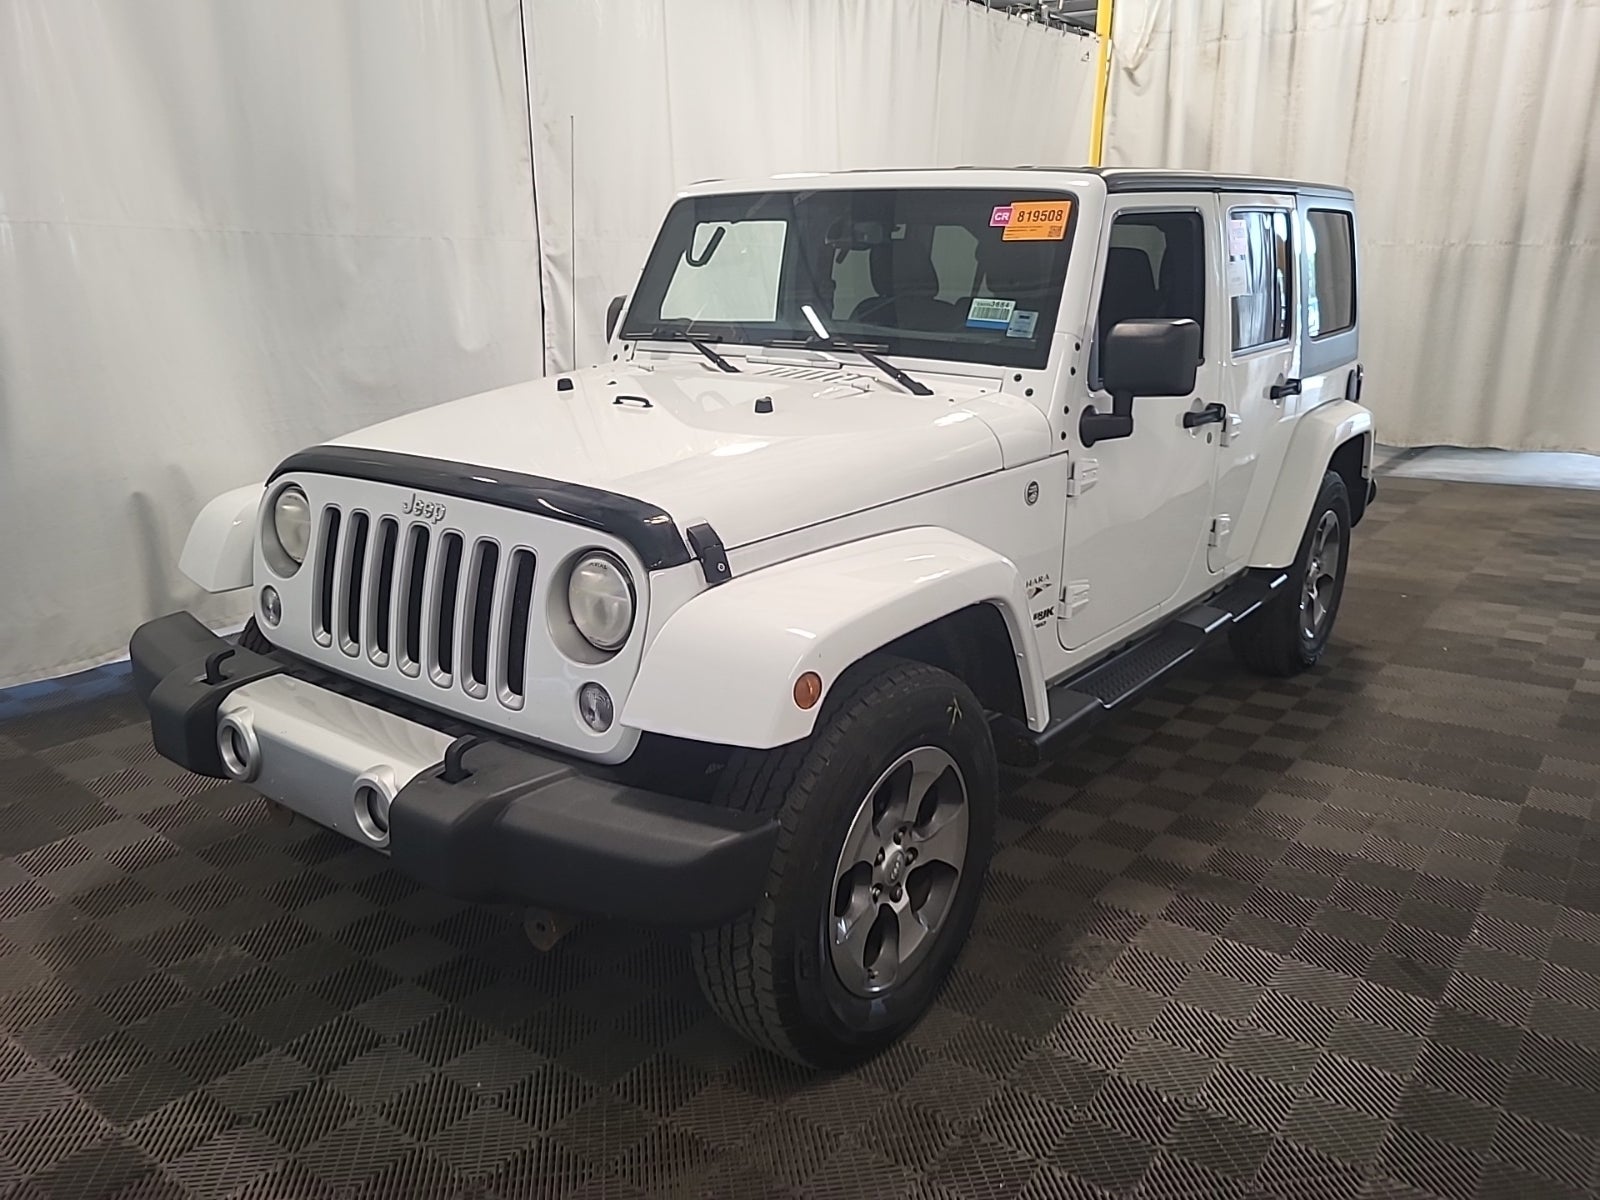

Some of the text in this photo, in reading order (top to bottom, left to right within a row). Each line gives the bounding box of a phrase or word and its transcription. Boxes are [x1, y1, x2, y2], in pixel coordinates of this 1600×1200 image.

[994, 212, 1010, 221] CR
[1017, 209, 1063, 222] 819508
[402, 492, 446, 525] Jeep
